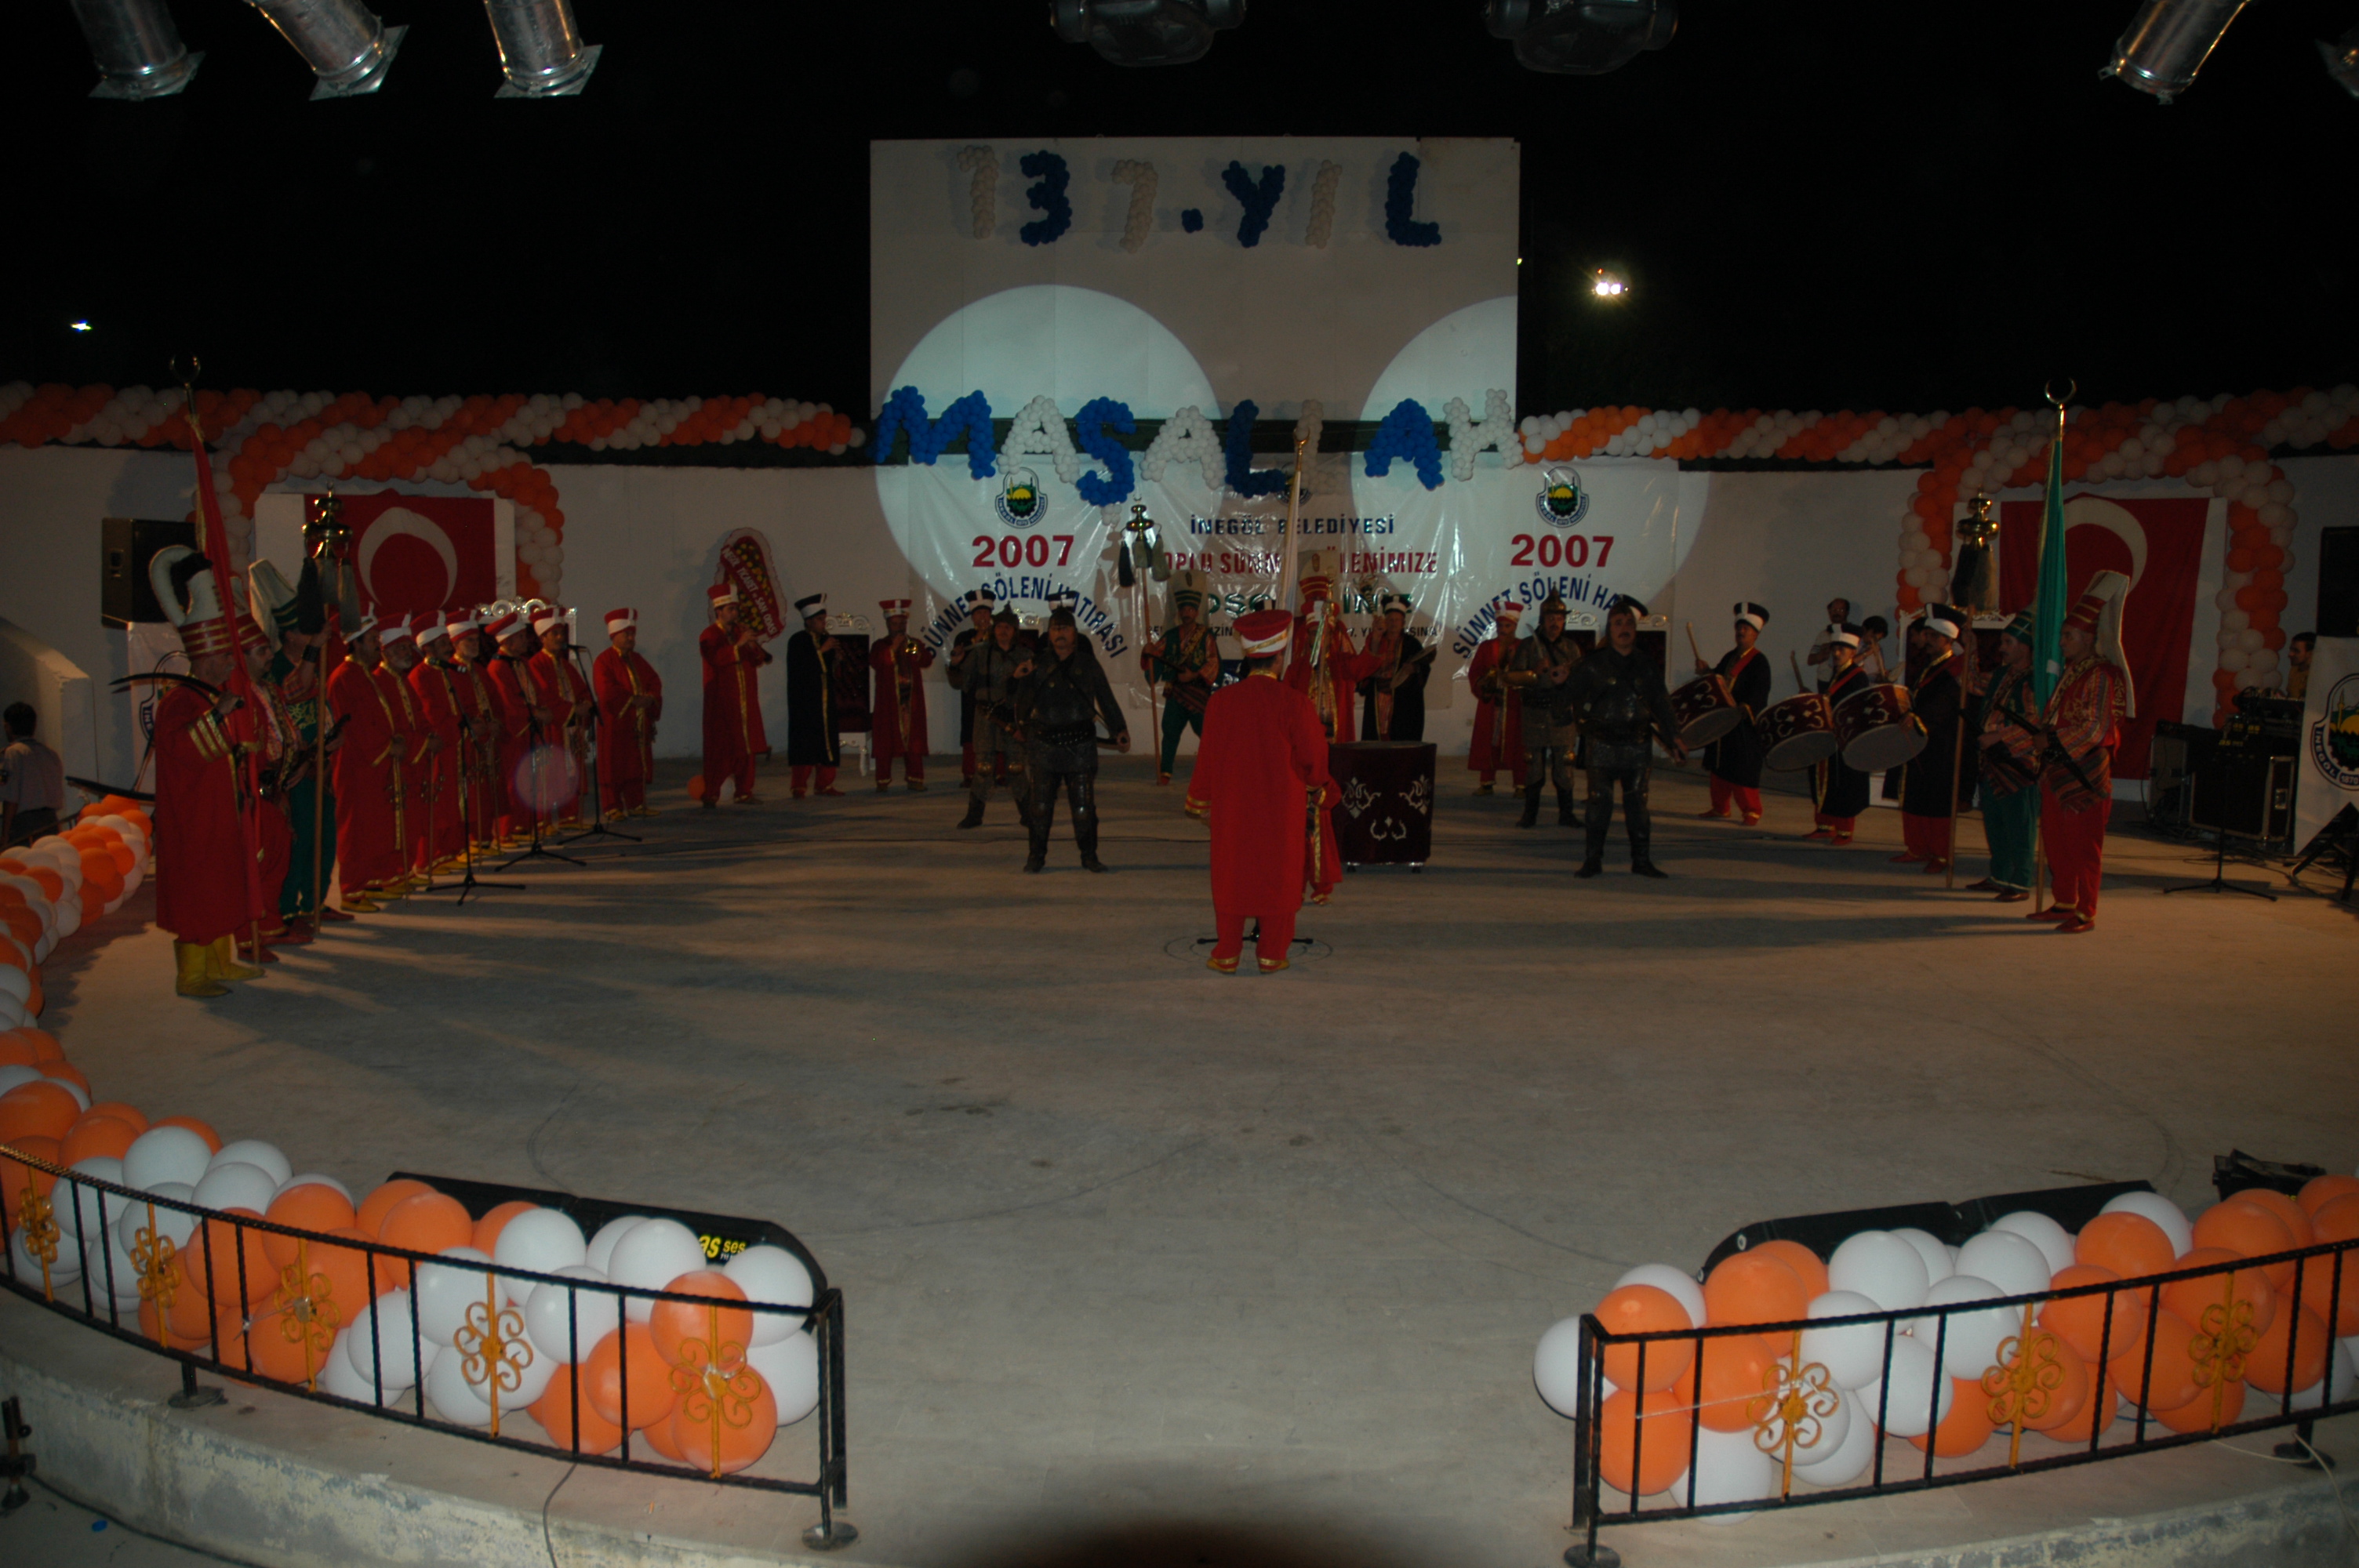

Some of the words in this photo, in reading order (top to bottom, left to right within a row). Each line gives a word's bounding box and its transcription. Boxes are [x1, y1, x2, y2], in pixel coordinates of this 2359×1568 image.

[1190, 514, 1266, 535] İNEGÖL
[1278, 514, 1394, 535] BLEDİYESİ
[972, 535, 1074, 568] 2007
[1510, 534, 1615, 568] 2007
